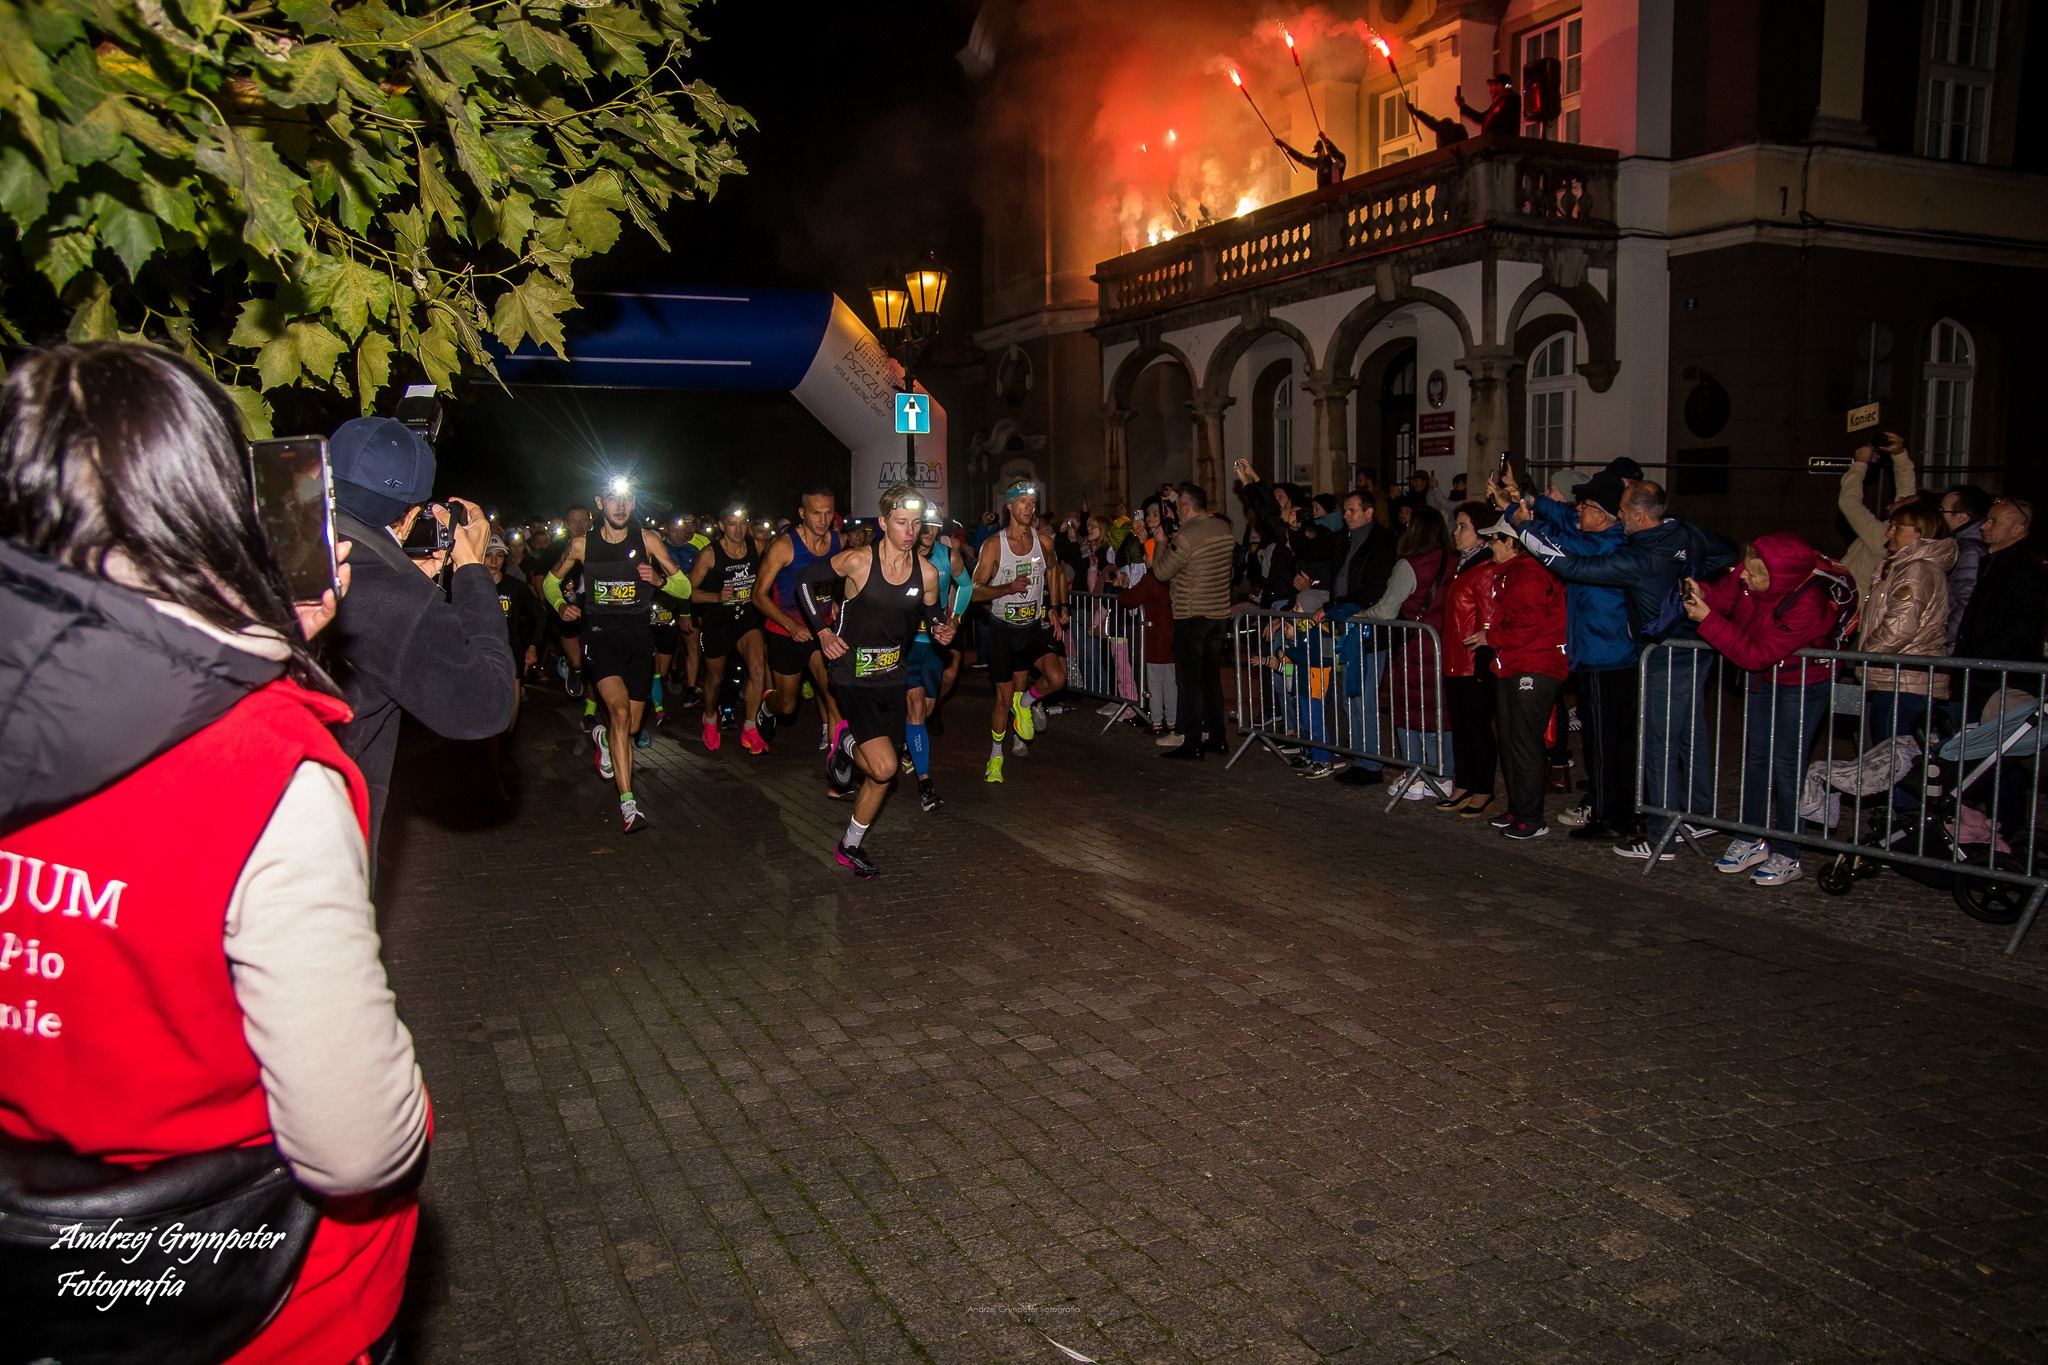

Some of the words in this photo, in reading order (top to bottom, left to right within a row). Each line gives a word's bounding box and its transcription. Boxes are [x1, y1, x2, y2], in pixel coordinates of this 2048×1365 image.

[1850, 410, 1877, 427] Koniec
[613, 585, 636, 598] 425
[879, 650, 900, 667] 389
[0, 850, 128, 929] JUM
